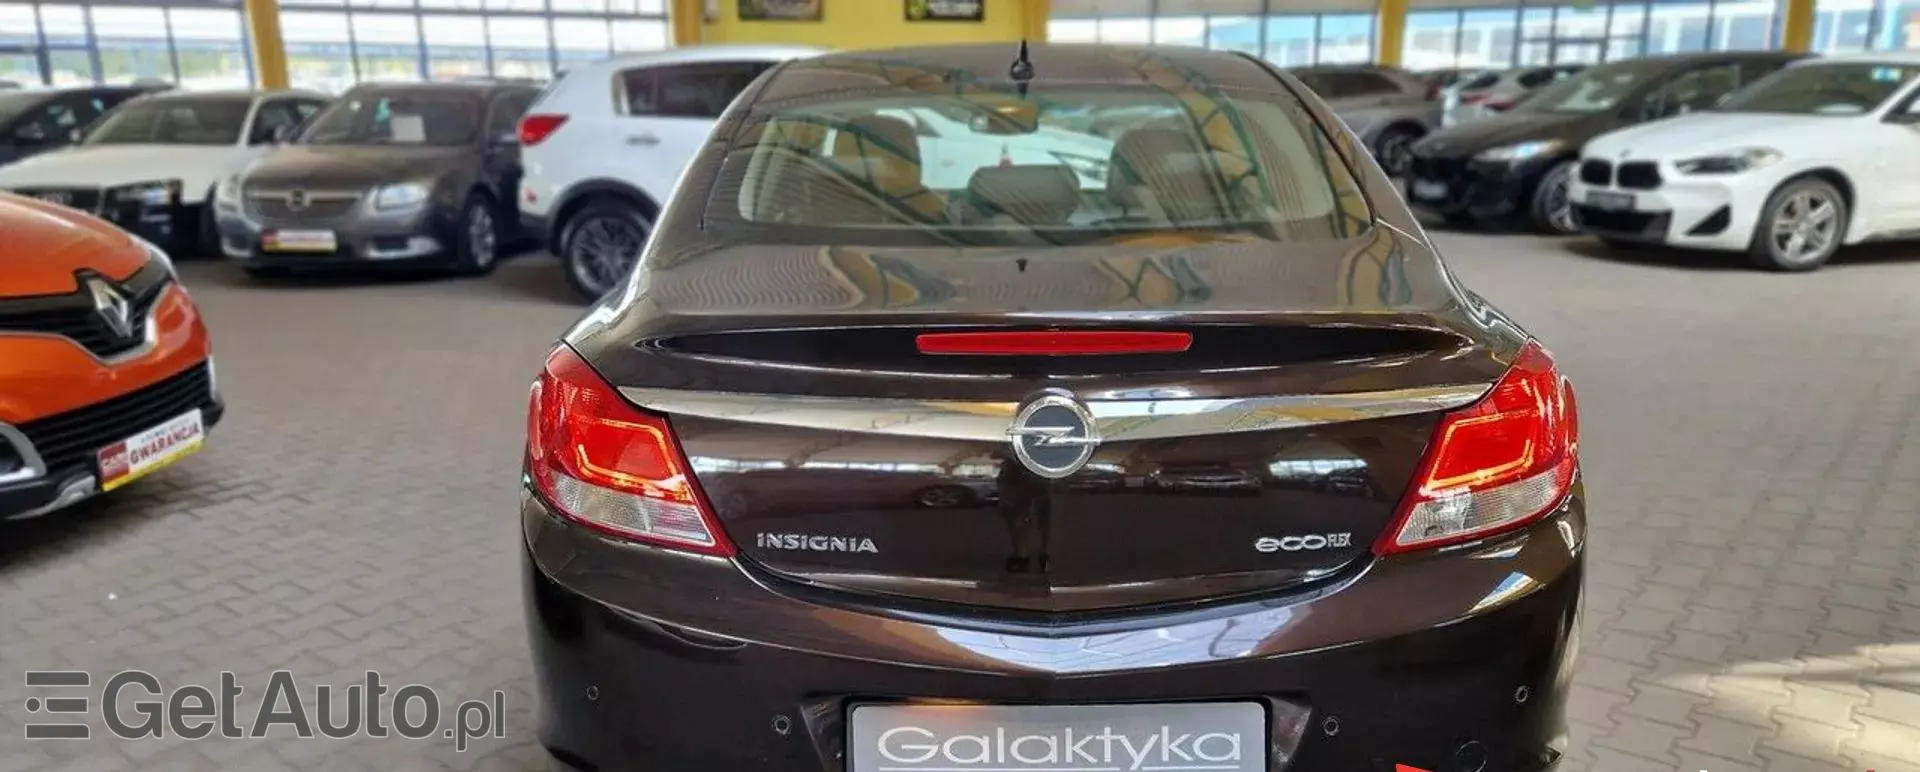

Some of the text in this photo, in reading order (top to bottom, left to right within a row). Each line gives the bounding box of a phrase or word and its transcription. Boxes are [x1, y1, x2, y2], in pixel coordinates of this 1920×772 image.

[130, 421, 200, 465] GWARANCJA
[756, 532, 879, 553] INSIGNIA
[878, 726, 1241, 771] Galaktyka
